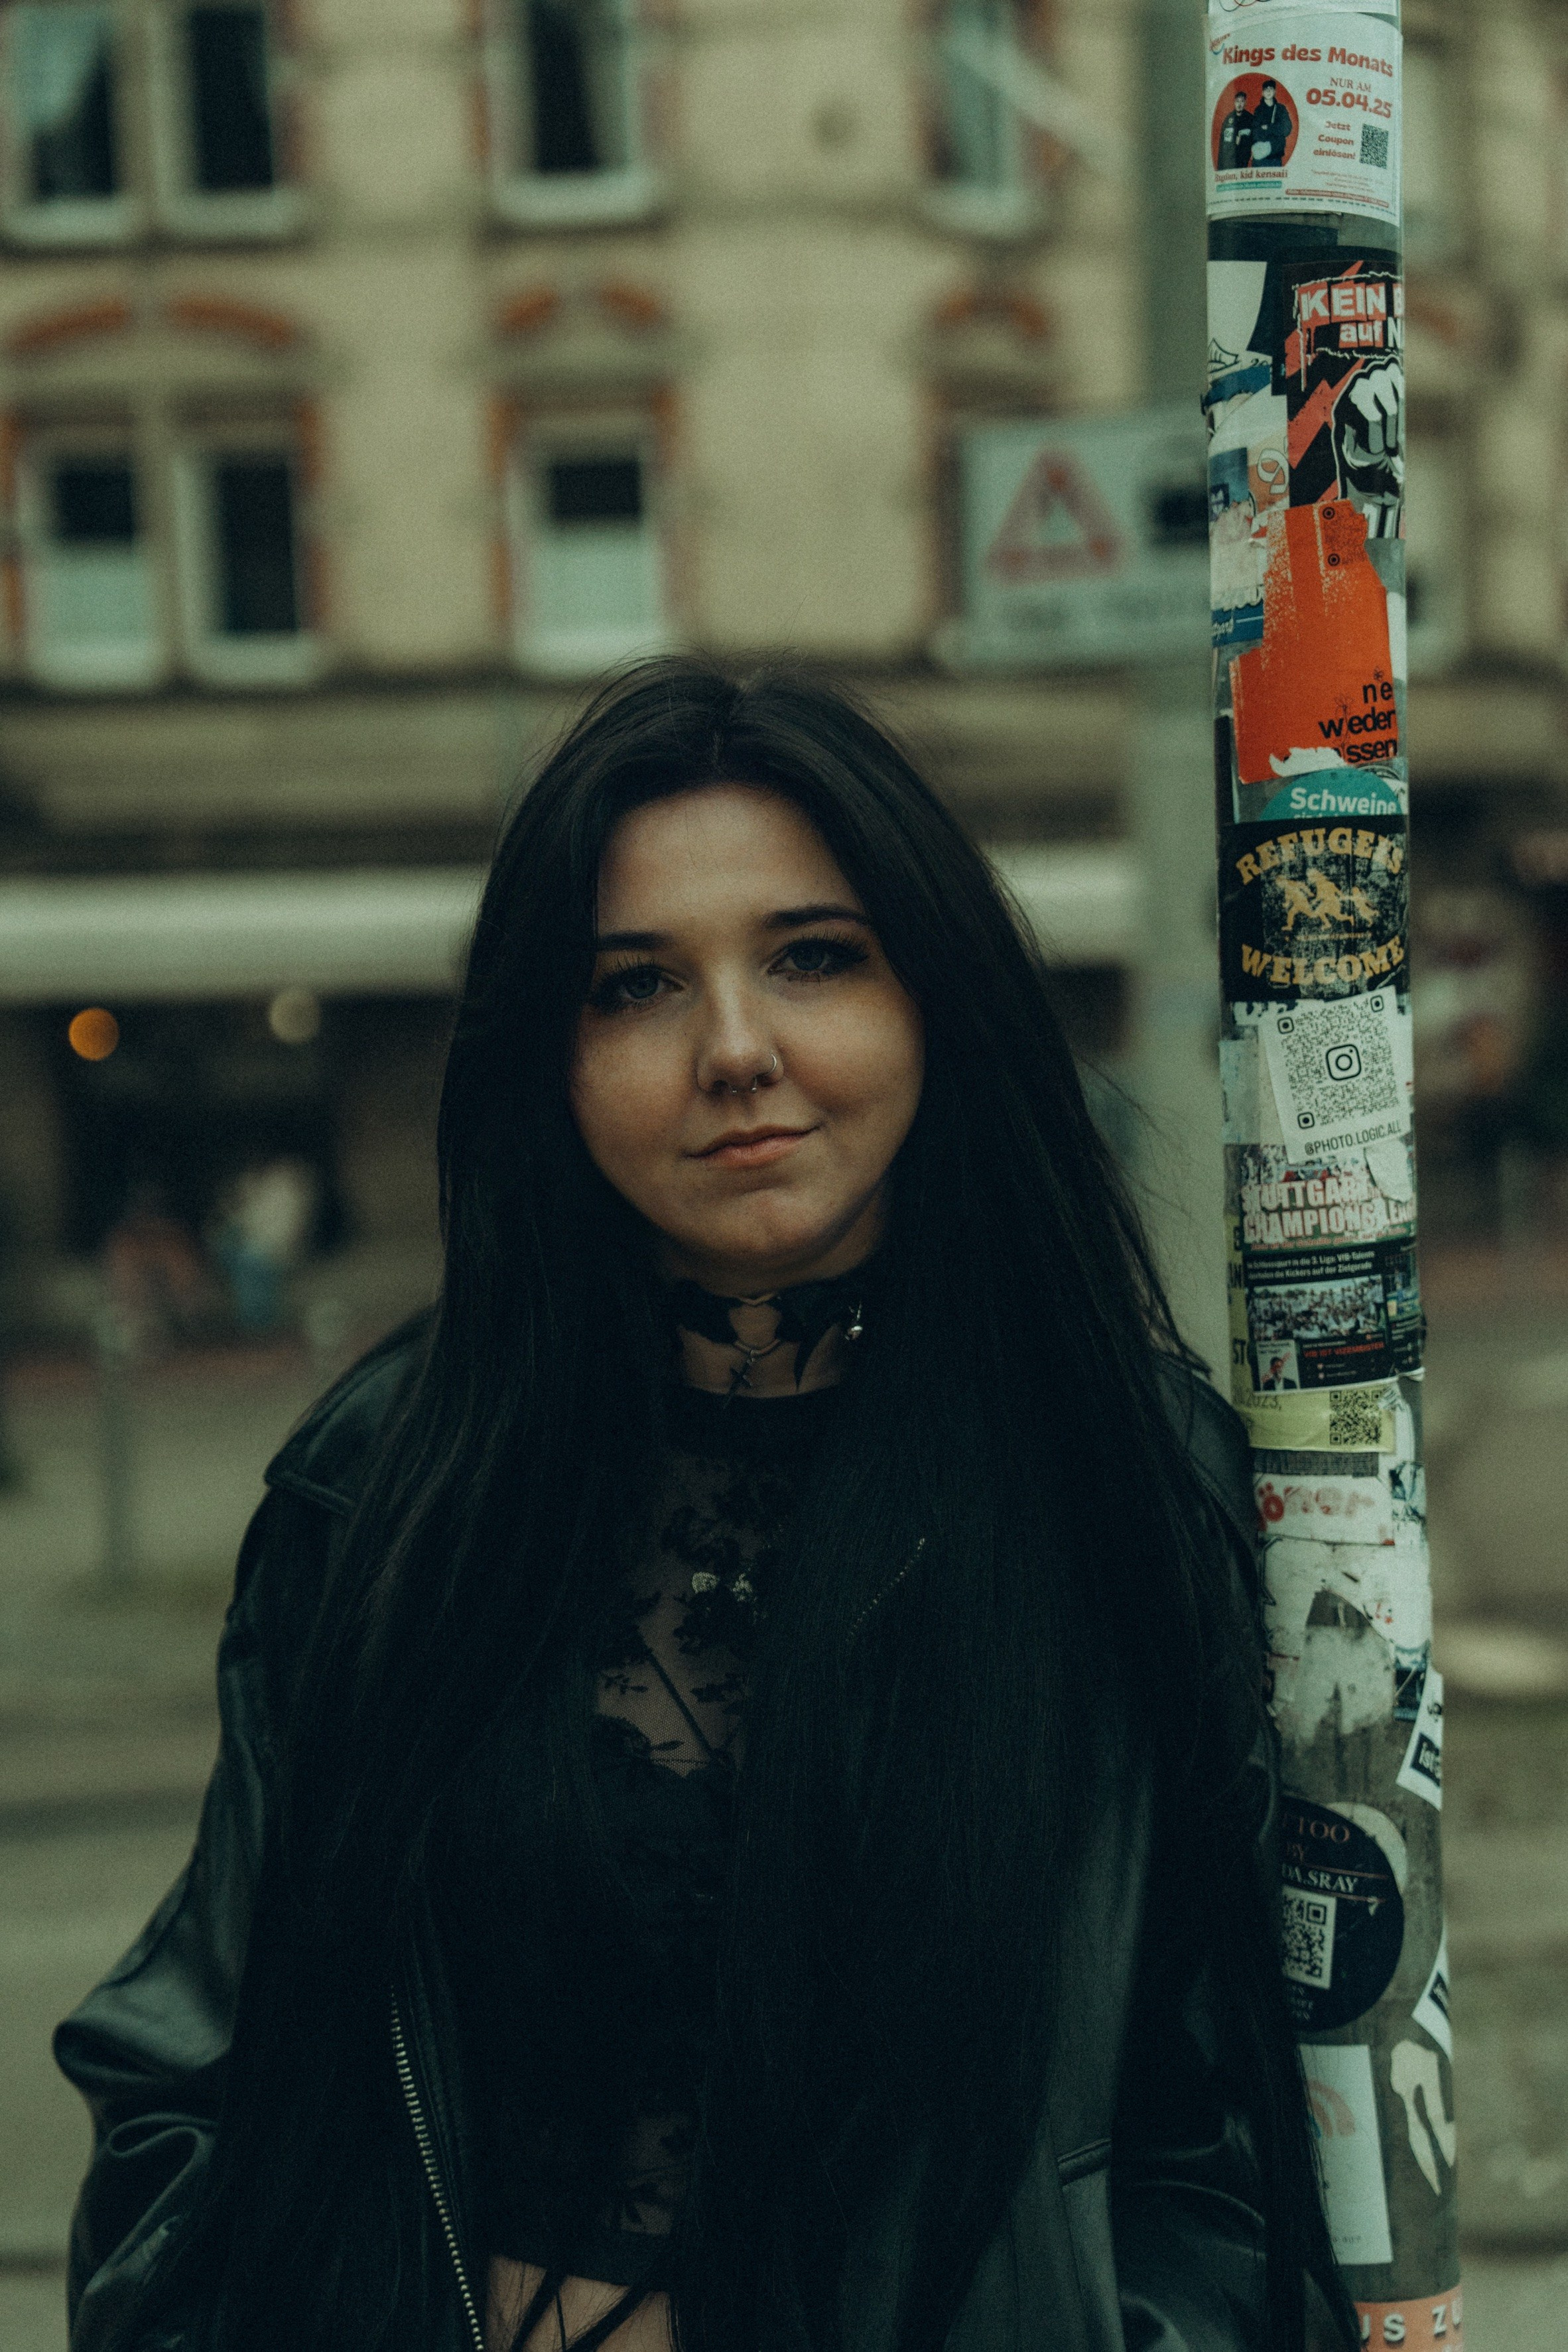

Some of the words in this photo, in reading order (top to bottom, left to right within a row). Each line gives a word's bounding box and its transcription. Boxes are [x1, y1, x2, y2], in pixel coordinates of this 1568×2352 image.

[1222, 44, 1275, 66] Kings
[1281, 44, 1321, 62] des
[1328, 46, 1394, 77] Monats
[1330, 77, 1353, 90] NUR
[1356, 82, 1372, 92] AM
[1306, 88, 1392, 119] 05.04.25
[1325, 121, 1351, 131] Jetzt
[1318, 135, 1354, 146] Coupon
[1301, 288, 1386, 320] KEIN
[1340, 322, 1382, 343] auf
[1318, 707, 1396, 739] weder
[1333, 738, 1398, 763] ssen
[1290, 787, 1397, 815] Schweine
[1242, 935, 1404, 985] WELCOME
